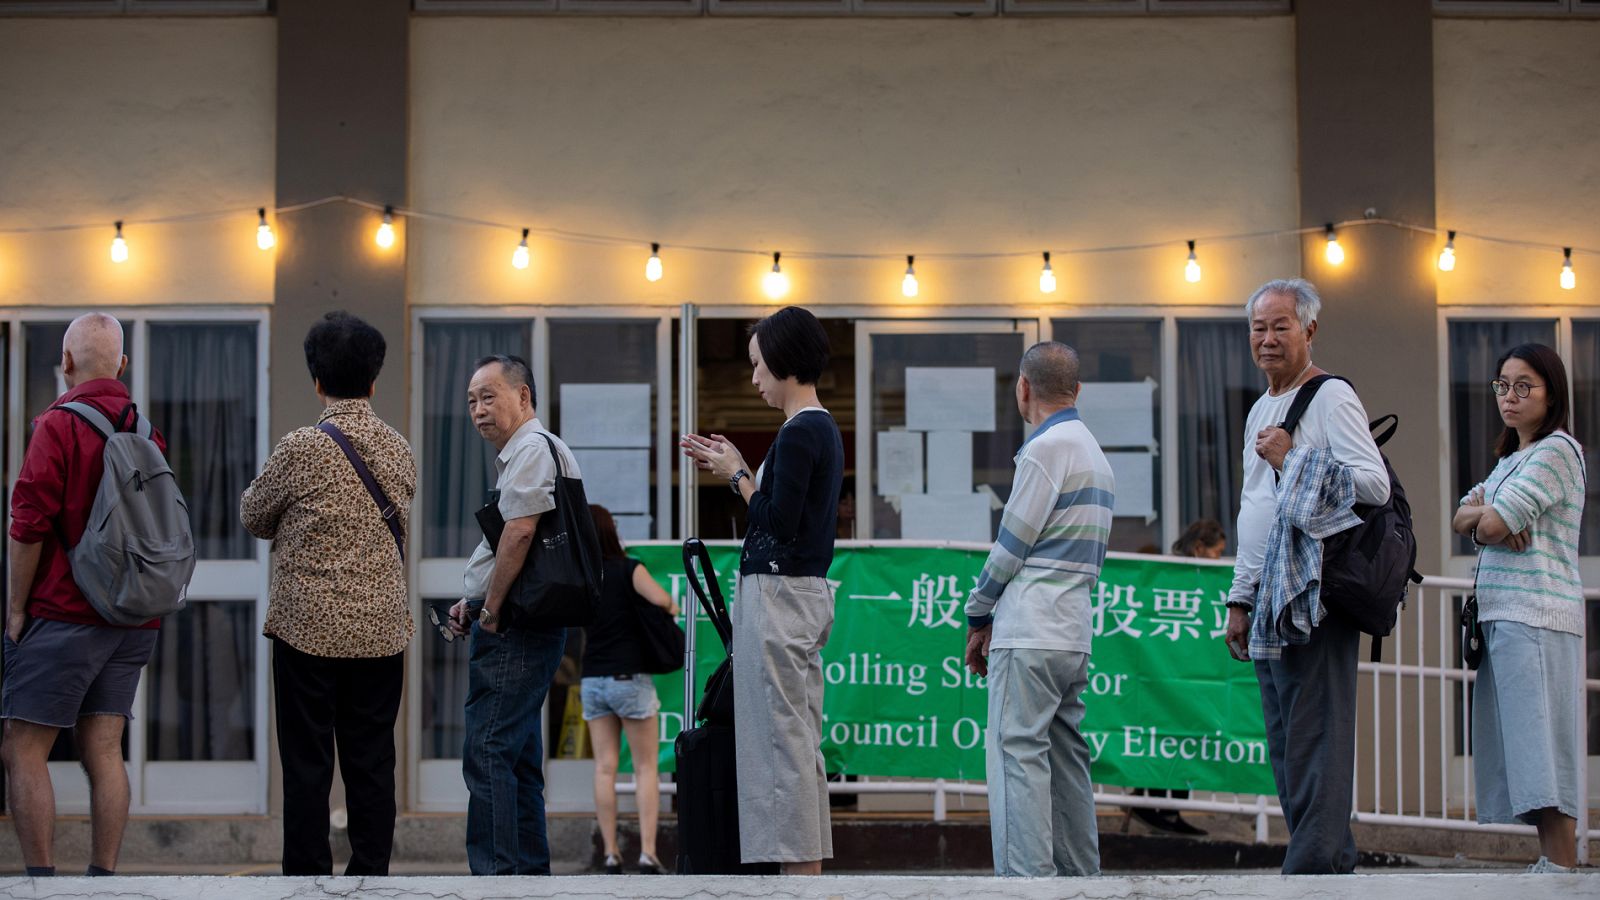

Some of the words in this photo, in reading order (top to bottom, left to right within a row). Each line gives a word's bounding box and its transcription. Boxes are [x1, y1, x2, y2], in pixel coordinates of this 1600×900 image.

[825, 652, 927, 696] olling
[821, 713, 938, 748] ouncil
[1121, 725, 1267, 765] Election
